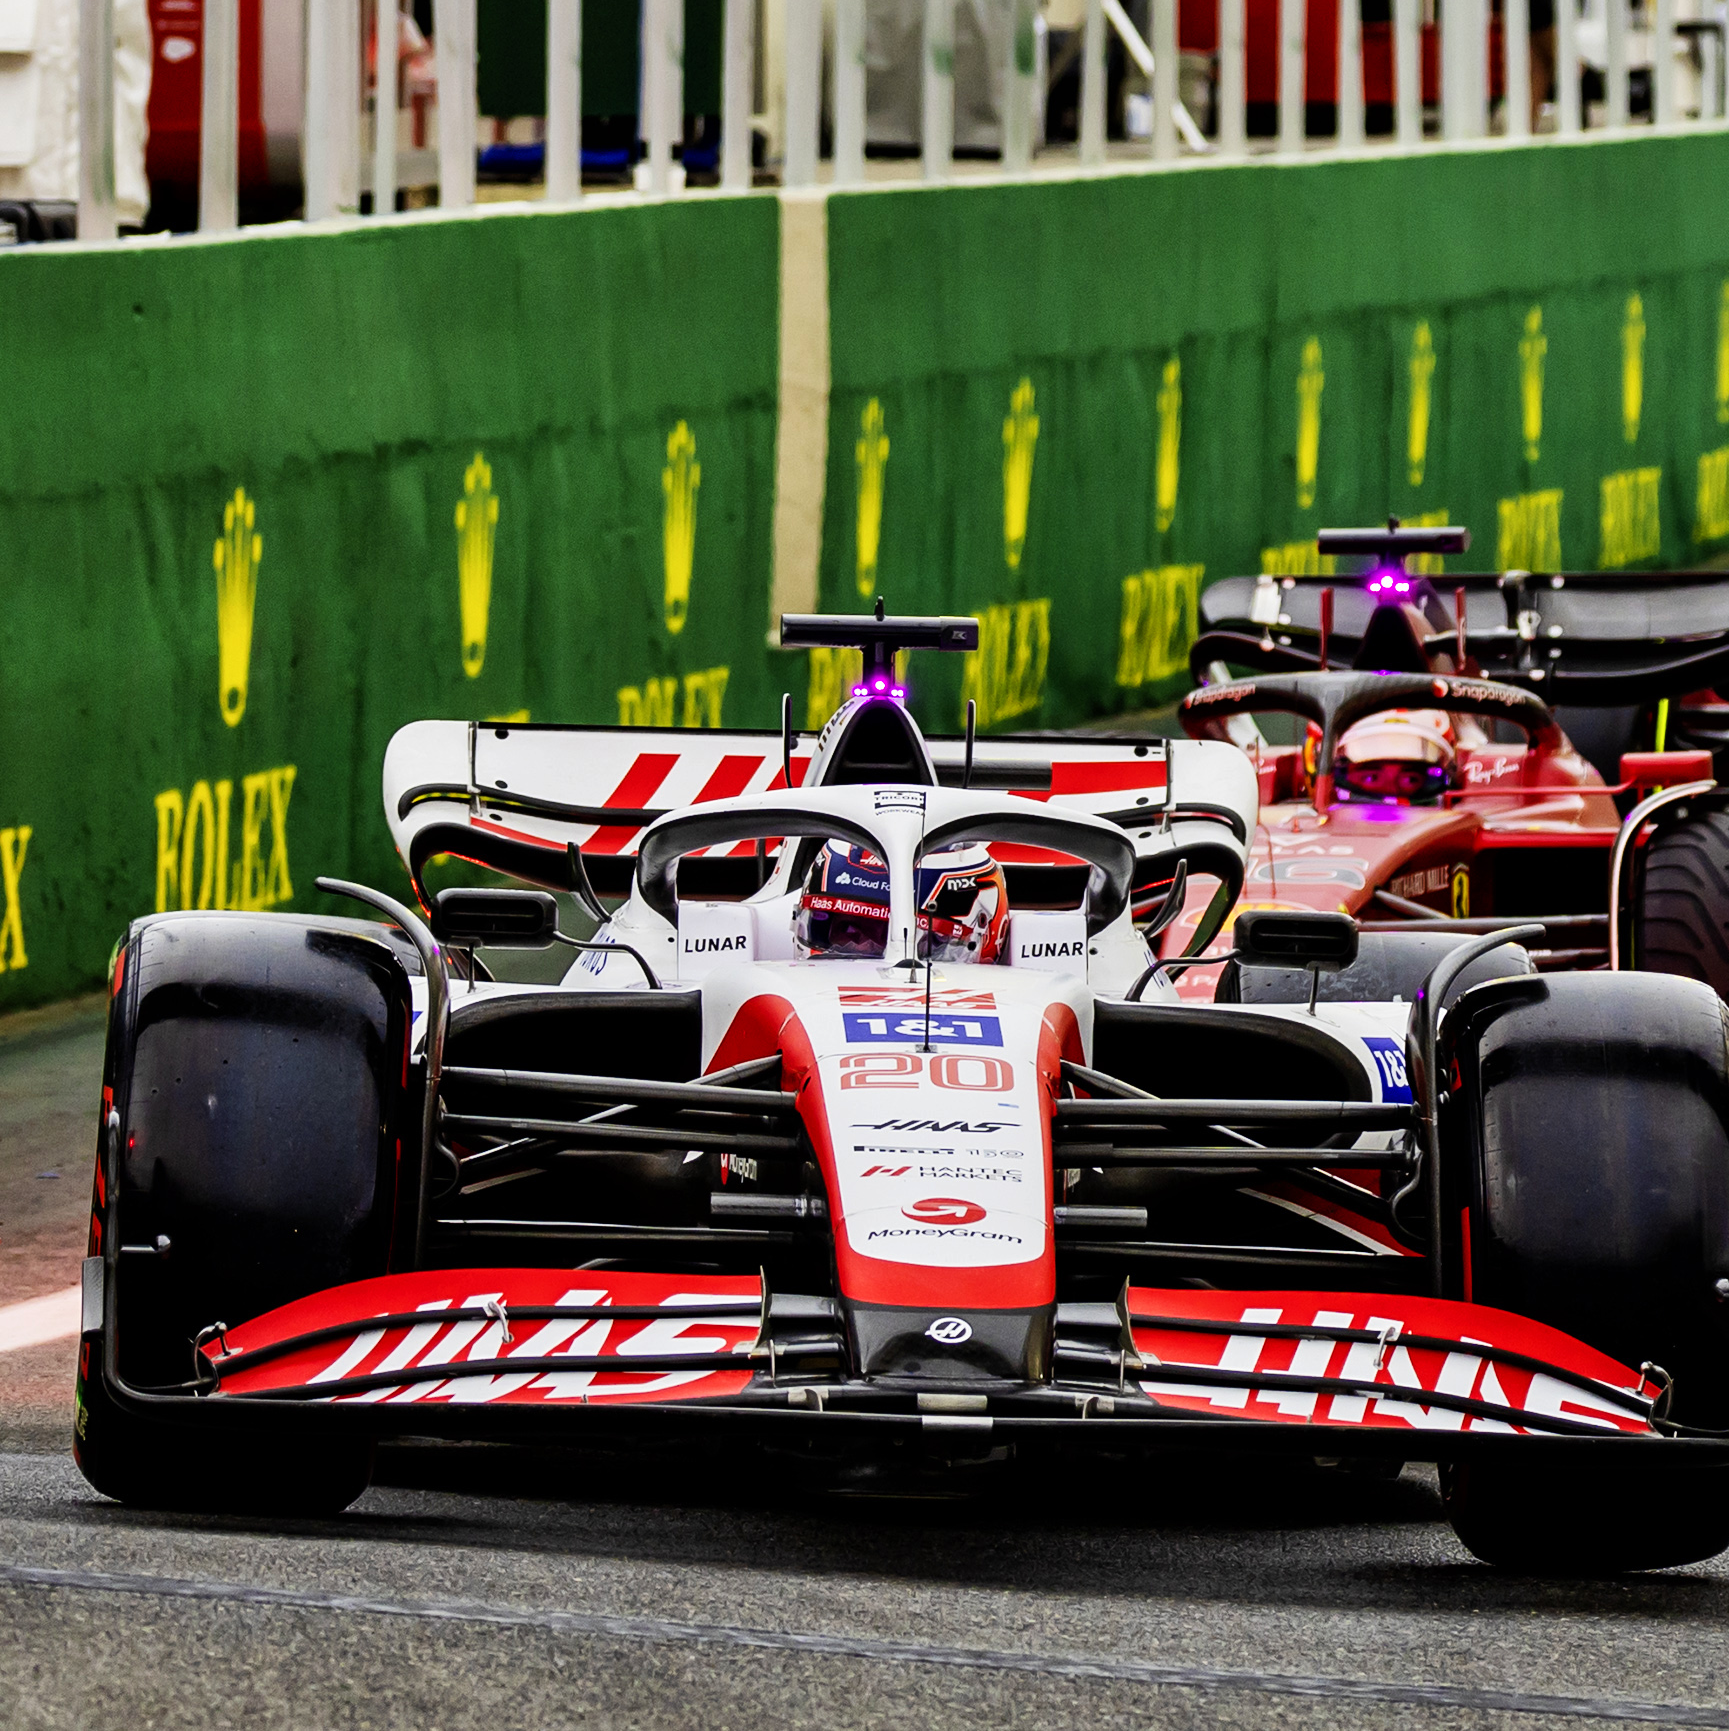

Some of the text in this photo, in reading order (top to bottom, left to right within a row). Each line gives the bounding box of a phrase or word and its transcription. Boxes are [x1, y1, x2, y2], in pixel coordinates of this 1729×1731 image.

[155, 765, 296, 911] ROLEX
[852, 876, 880, 889] Cloud
[810, 896, 833, 910] Haas
[684, 935, 747, 953] LUNAR
[1020, 941, 1084, 958] LUNAR
[856, 1018, 983, 1038] 1&1
[839, 1052, 1015, 1092] 20
[849, 1119, 1023, 1133] HAAS
[919, 1166, 1023, 1175] HANTEC
[919, 1172, 1023, 1183] MARKETS
[867, 1227, 1023, 1244] MoneyGram
